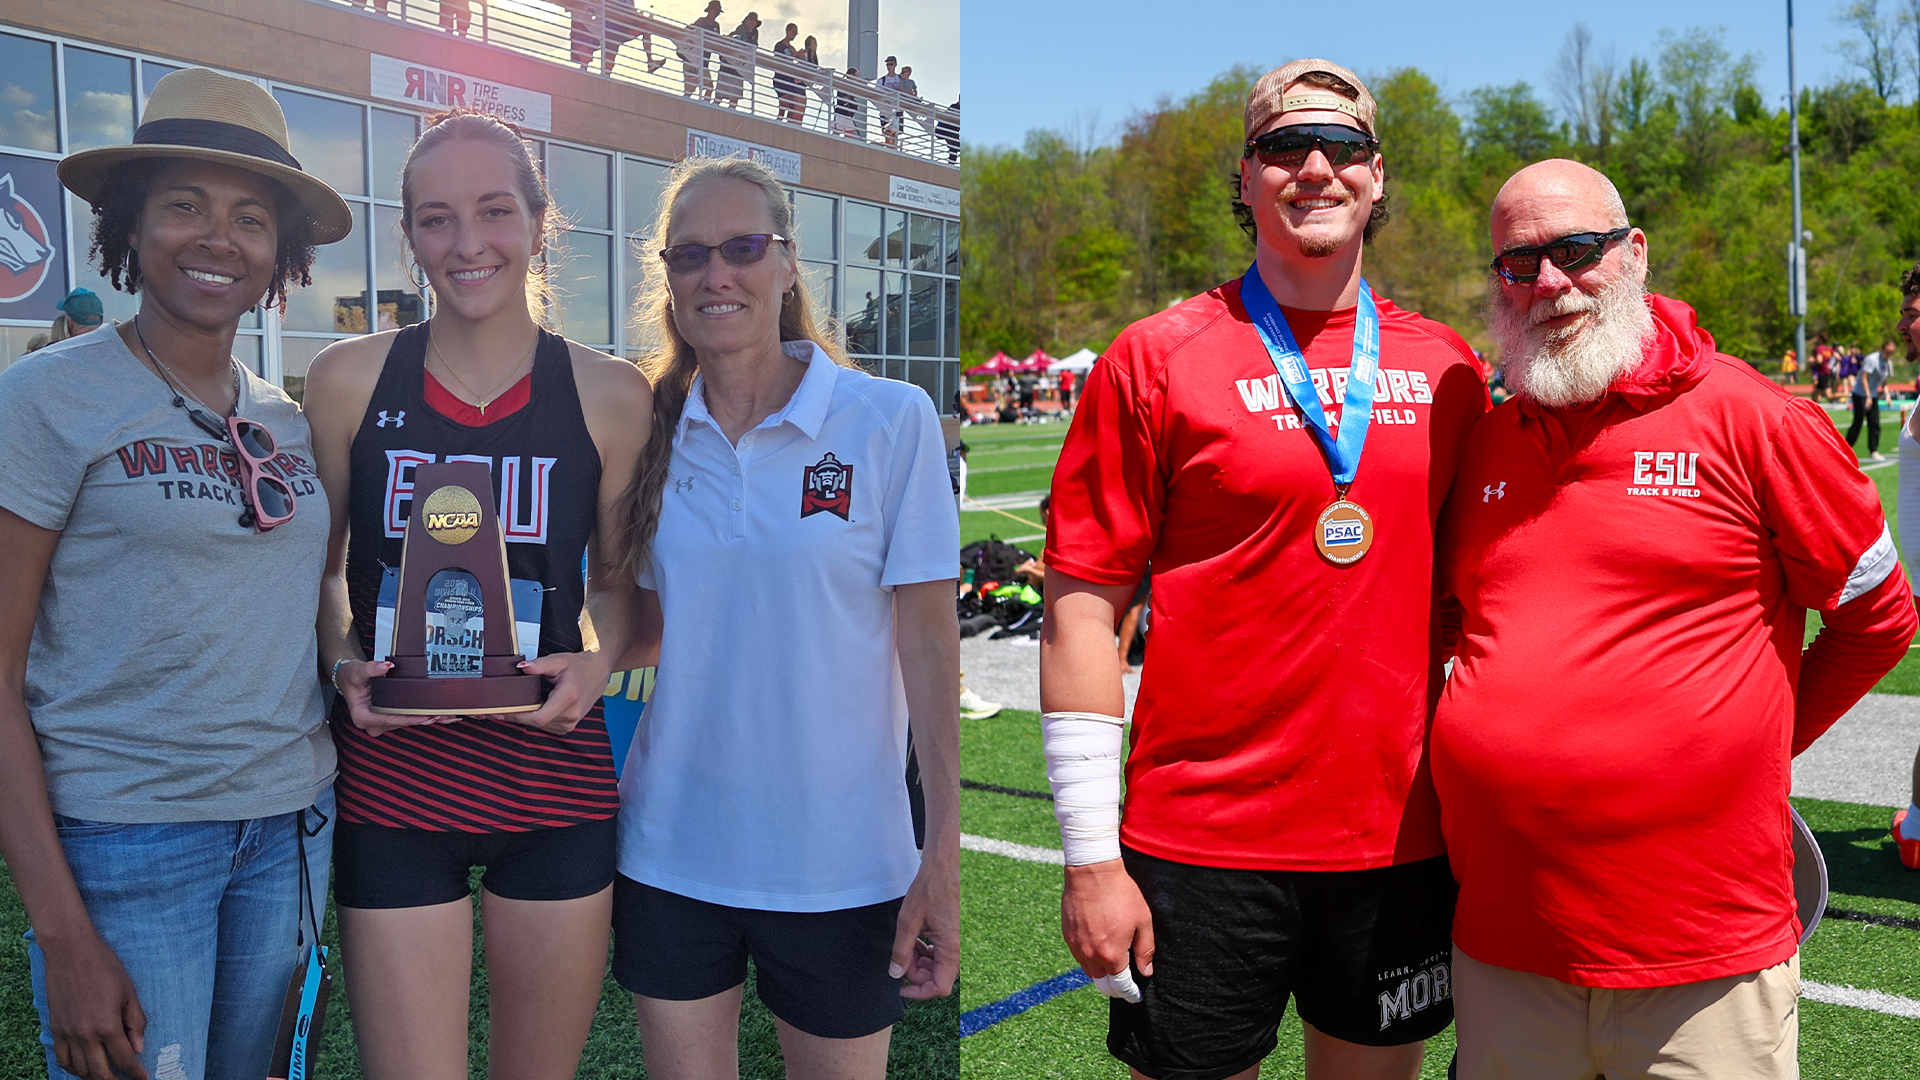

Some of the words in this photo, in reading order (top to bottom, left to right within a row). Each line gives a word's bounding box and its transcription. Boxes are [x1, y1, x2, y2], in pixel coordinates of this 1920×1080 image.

[404, 66, 466, 107] RNR
[472, 82, 499, 100] TIRE
[472, 98, 525, 121] EXPRESS
[1286, 357, 1302, 382] PSAC
[1235, 367, 1433, 412] WRRORS
[1271, 411, 1339, 431] TRAK
[116, 440, 321, 488] WARRRS
[1633, 451, 1700, 486] ESU
[158, 481, 236, 505] TRACK
[384, 449, 558, 545] EU
[1626, 487, 1659, 496] TRACK
[1662, 488, 1669, 496] &
[1672, 488, 1701, 498] FIELD
[428, 512, 479, 531] NCAA
[1320, 505, 1339, 524] OUTDOOR
[1357, 508, 1369, 521] FIELD
[1326, 526, 1361, 538] PSAC
[436, 602, 483, 612] CHAMPIONSHIPS
[1378, 966, 1413, 981] LEARN.
[1378, 962, 1453, 1032] MOR
